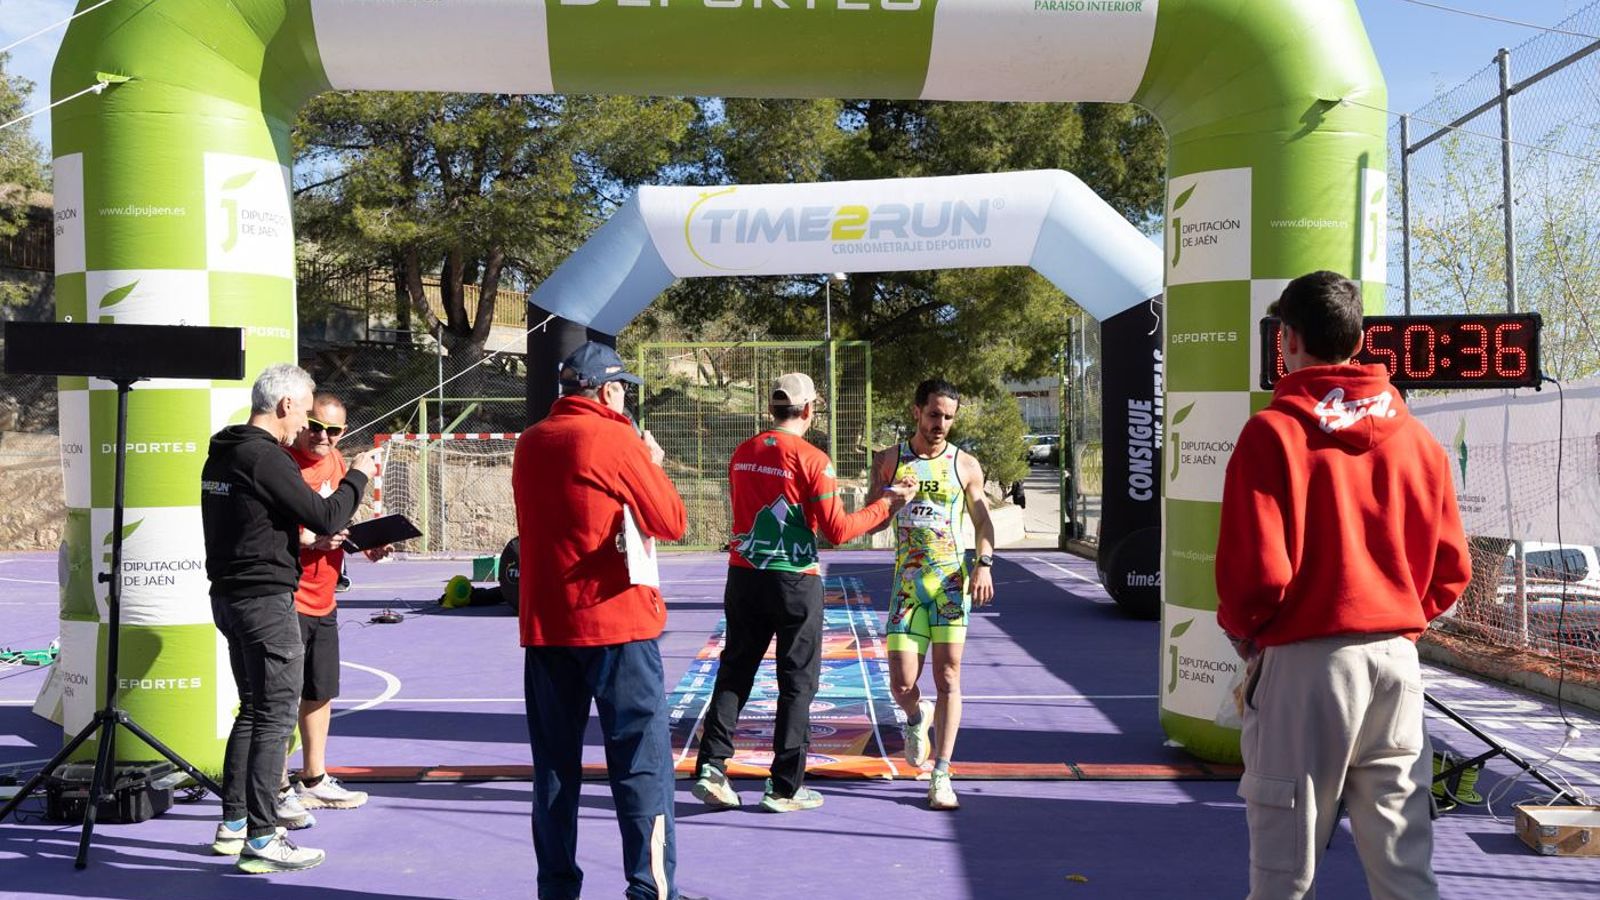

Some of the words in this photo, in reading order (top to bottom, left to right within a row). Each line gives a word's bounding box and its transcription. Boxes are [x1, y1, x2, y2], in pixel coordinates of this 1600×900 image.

[1087, 1, 1142, 12] INTERIOR
[98, 204, 186, 218] www.dipujaen.es
[1182, 218, 1240, 234] DIPUTACIÓN
[1270, 217, 1348, 231] www.dipujaen.es
[831, 241, 924, 255] CRONOMETRAJE
[926, 238, 991, 250] DEPORTIVO
[1182, 237, 1193, 248] DE
[1194, 235, 1218, 246] JAÉN
[1172, 331, 1237, 344] DEPORTES
[1128, 399, 1153, 501] CONSIGUE
[1181, 455, 1192, 464] DE
[1192, 453, 1216, 465] JAÉN
[919, 481, 939, 492] 153
[911, 506, 933, 516] 472
[123, 560, 202, 572] DIPUTACIÓN
[123, 576, 140, 586] DE
[144, 573, 175, 586] JAÉN
[1179, 656, 1237, 673] DIPUTACIÓN
[119, 677, 202, 689] EPORTES
[1179, 670, 1190, 680] DE
[1190, 670, 1215, 684] JAÉN
